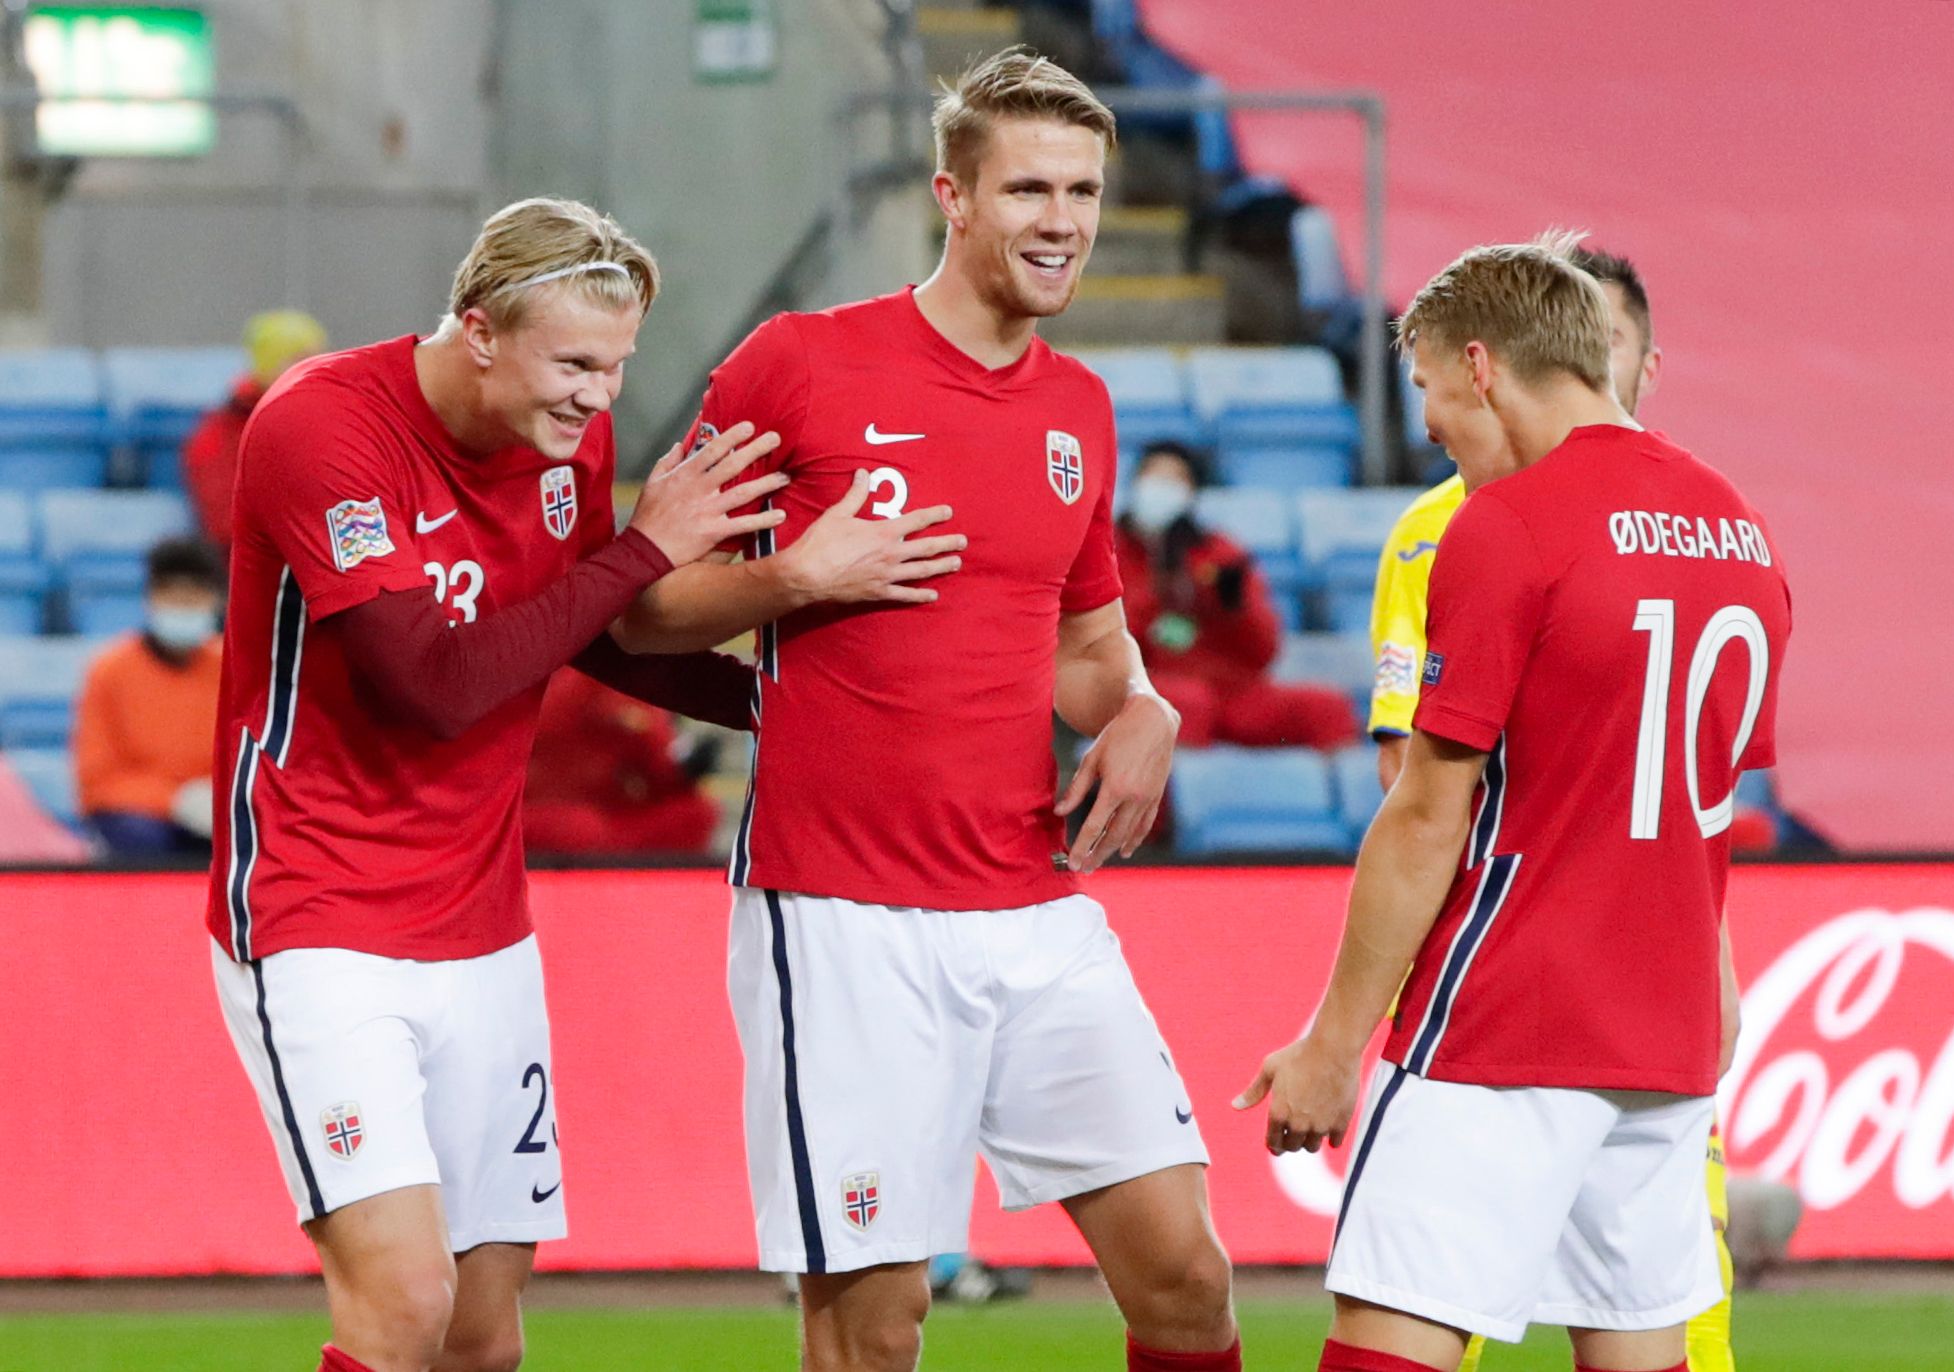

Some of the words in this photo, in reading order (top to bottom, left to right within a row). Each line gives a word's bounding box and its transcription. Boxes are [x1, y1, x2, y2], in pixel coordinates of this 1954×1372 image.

[868, 466, 908, 519] 3
[1609, 510, 1772, 568] ØDEGAARD
[1629, 598, 1769, 840] 10
[512, 1062, 559, 1153] 2
